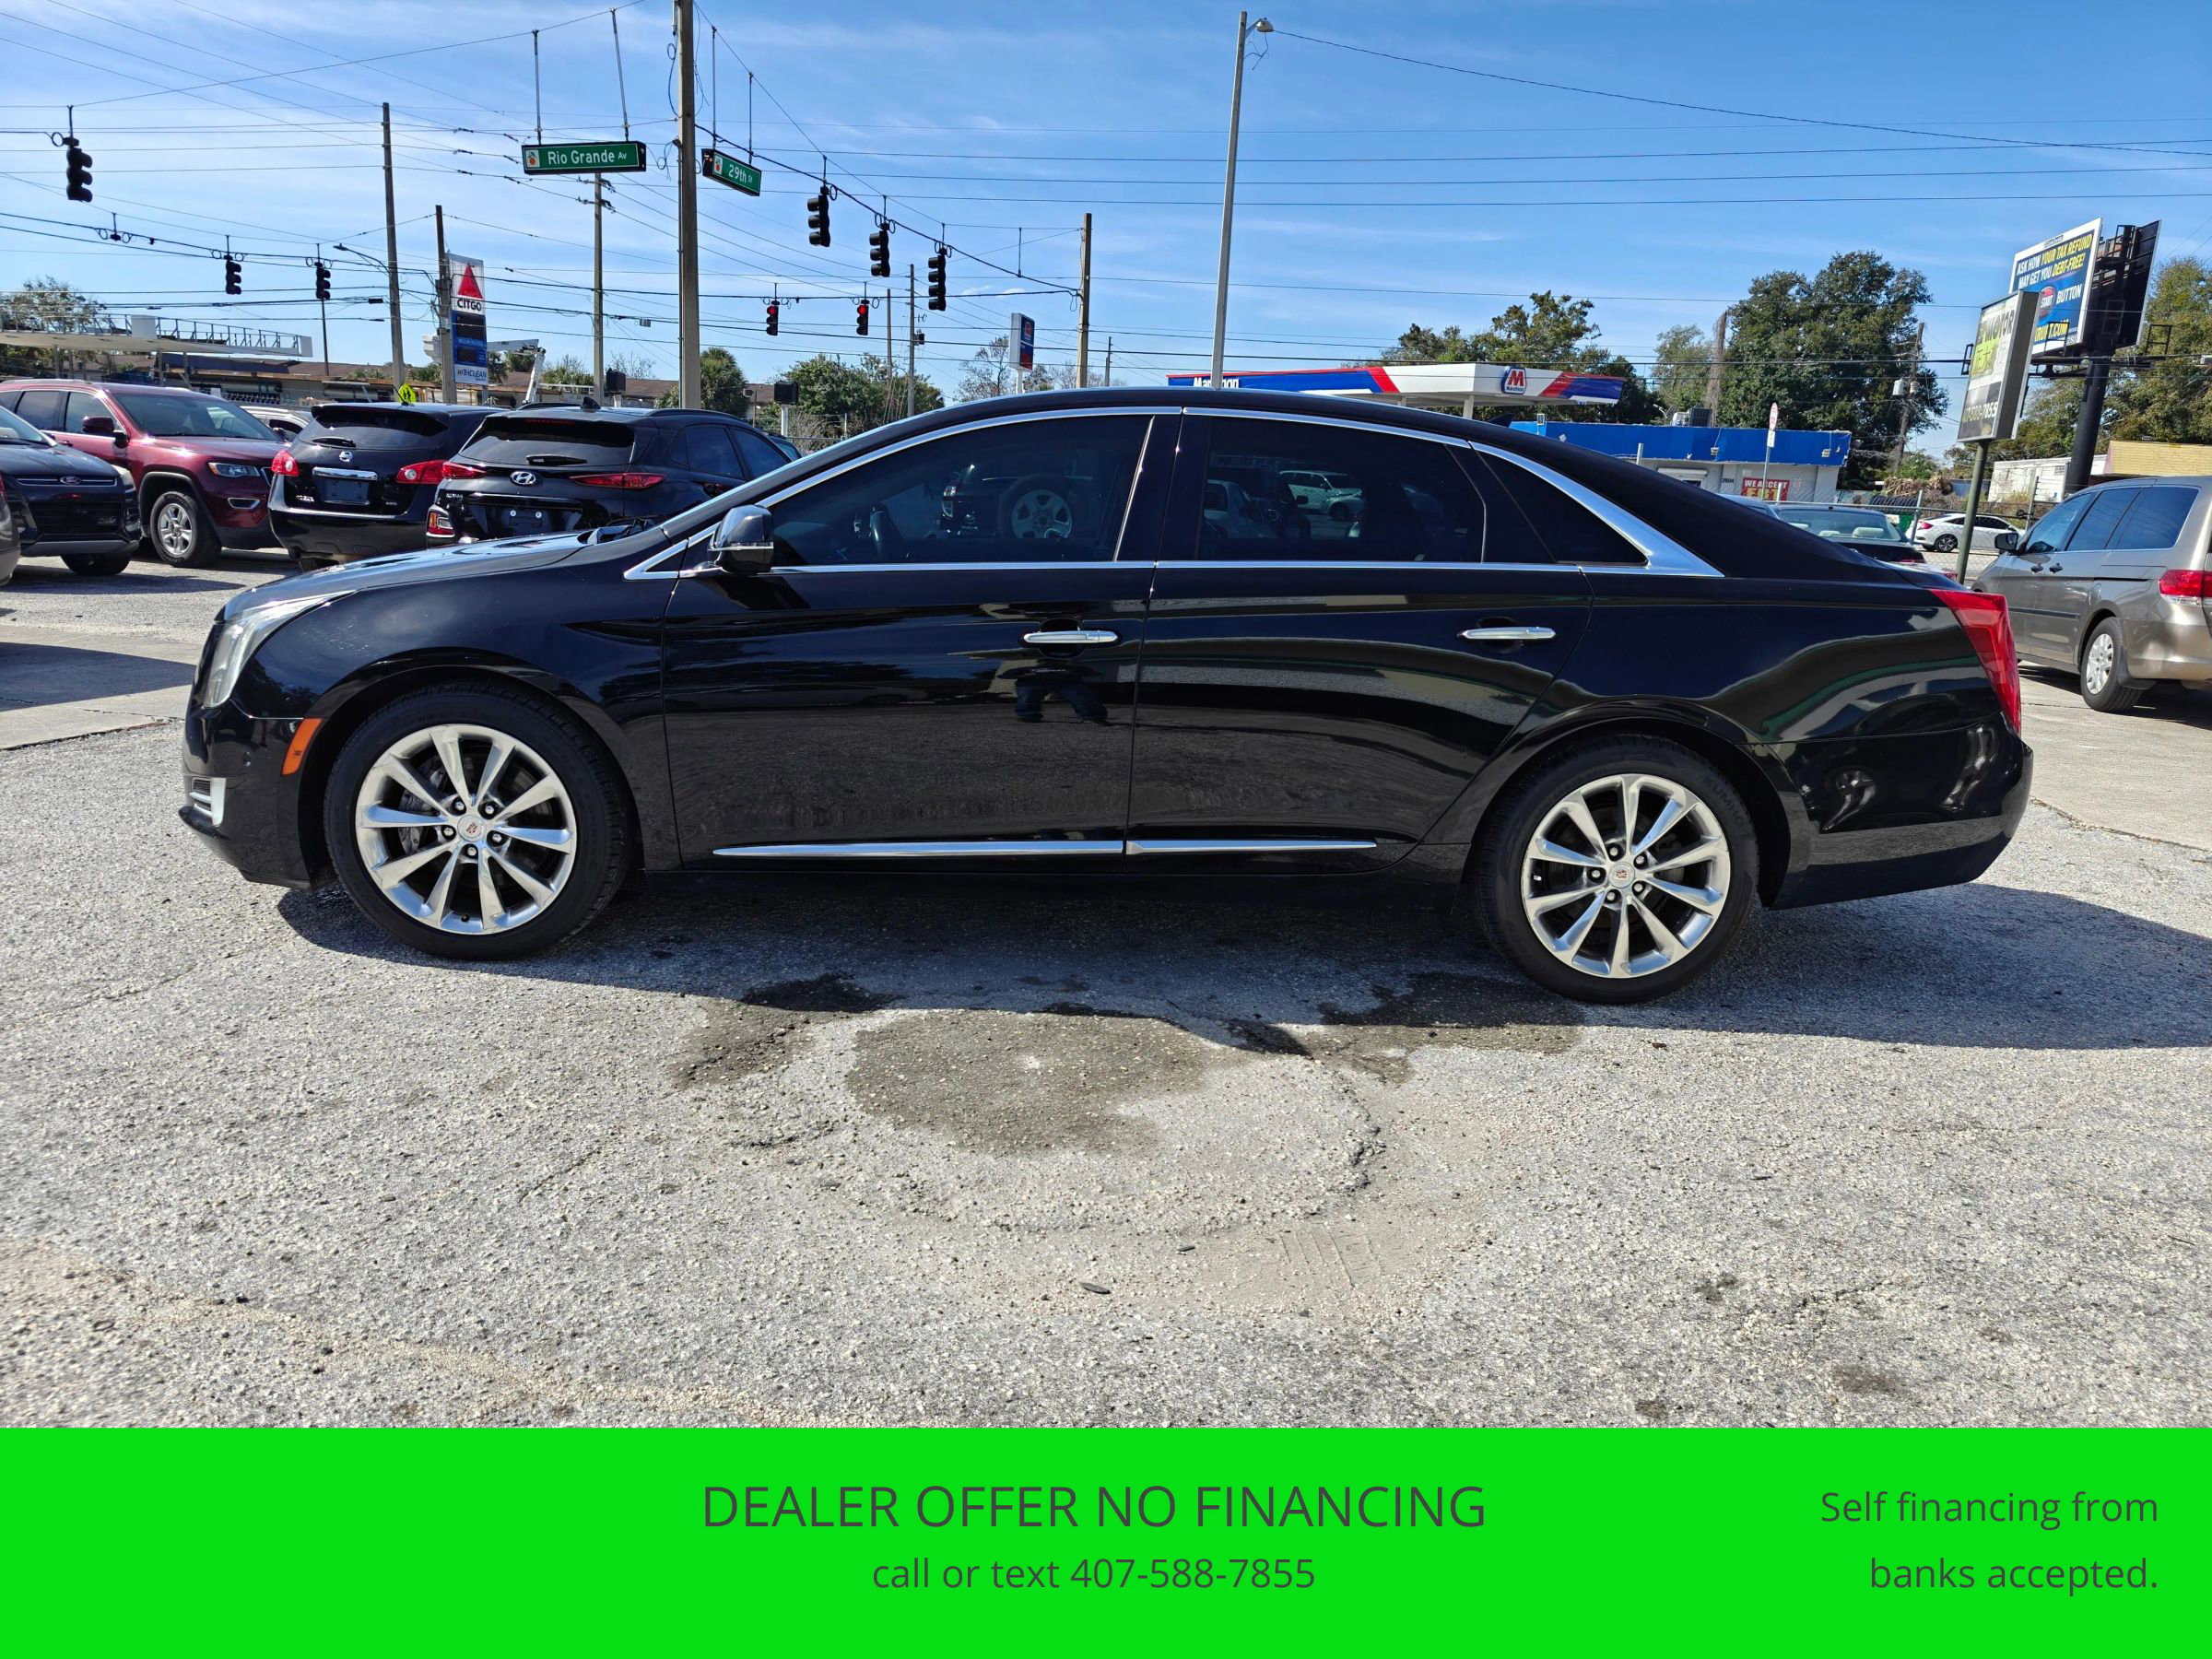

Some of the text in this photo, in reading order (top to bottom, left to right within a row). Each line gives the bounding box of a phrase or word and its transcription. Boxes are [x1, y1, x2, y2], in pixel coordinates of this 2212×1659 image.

[547, 150, 567, 165] Rio
[571, 149, 615, 164] Grande
[729, 164, 753, 183] 29th St
[2017, 260, 2028, 276] ASK
[2028, 254, 2041, 269] HOW
[2041, 248, 2056, 265] YOUR
[2056, 243, 2069, 260] TAX
[2067, 234, 2092, 256] REFUND
[2018, 275, 2029, 288] MAY
[2029, 270, 2041, 285] GET
[2041, 265, 2053, 281] YOU
[2056, 284, 2082, 304] BUTTON
[457, 299, 482, 312] CITGO
[1193, 376, 1240, 388] Marhon
[1508, 371, 1524, 386] M
[1745, 479, 1757, 488] WE
[1703, 775, 1744, 828] KUMHO
